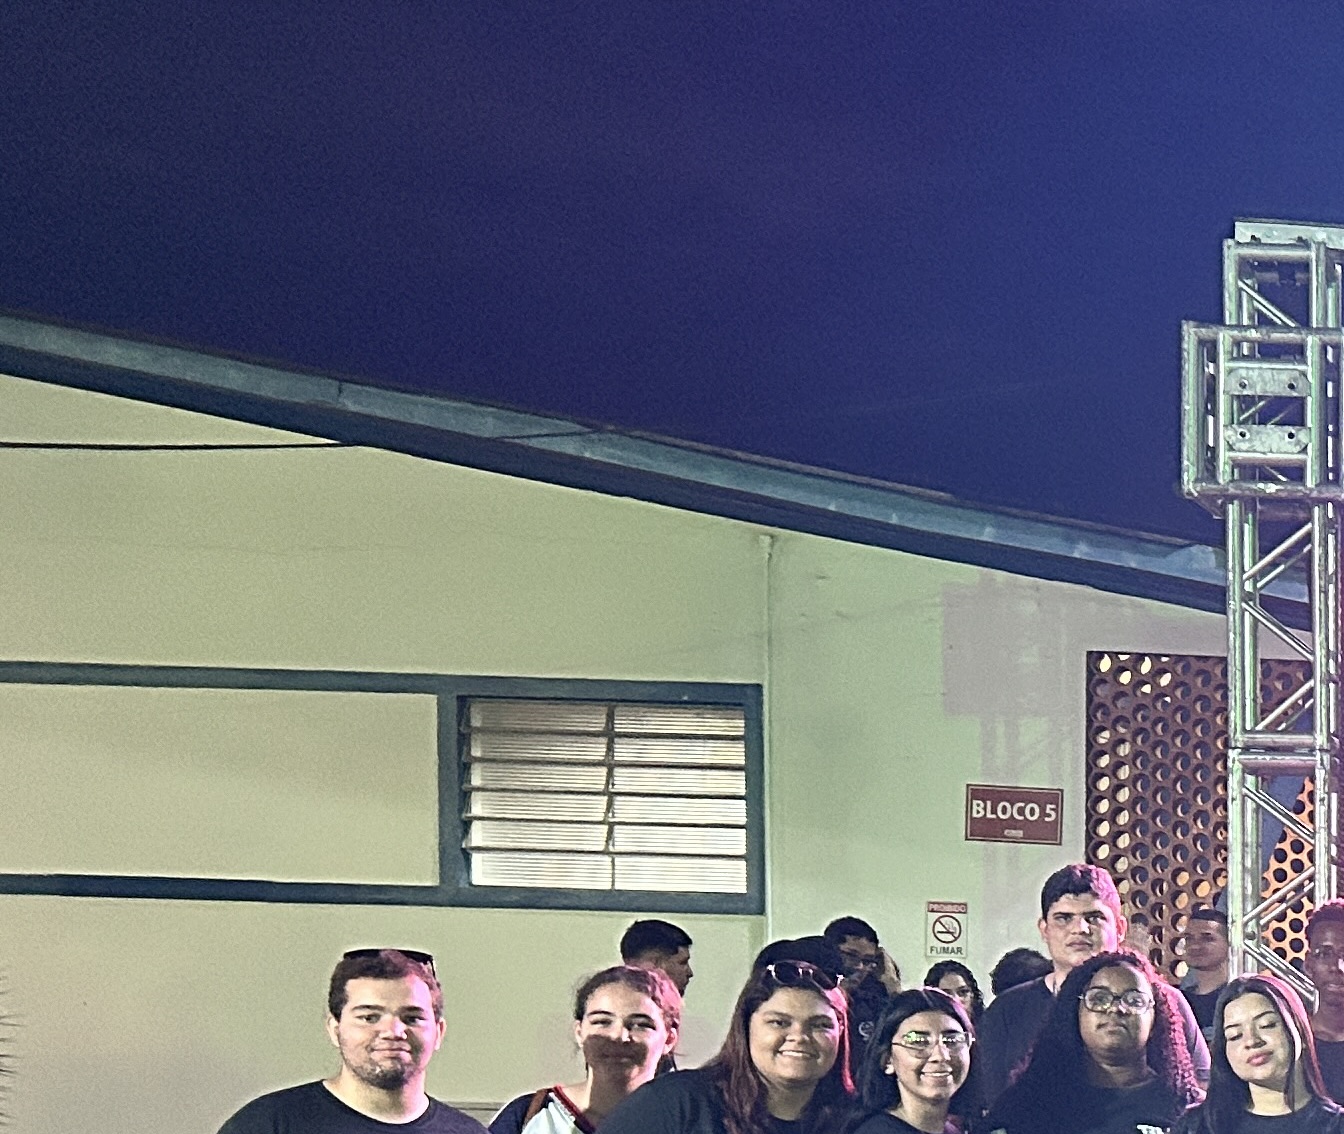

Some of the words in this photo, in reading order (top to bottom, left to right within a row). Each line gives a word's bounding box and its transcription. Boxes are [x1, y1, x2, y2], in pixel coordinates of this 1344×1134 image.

[972, 799, 1040, 821] BLOCO
[1044, 804, 1057, 822] 5
[928, 903, 966, 912] PROIBIDO
[930, 946, 963, 955] FUMAR
